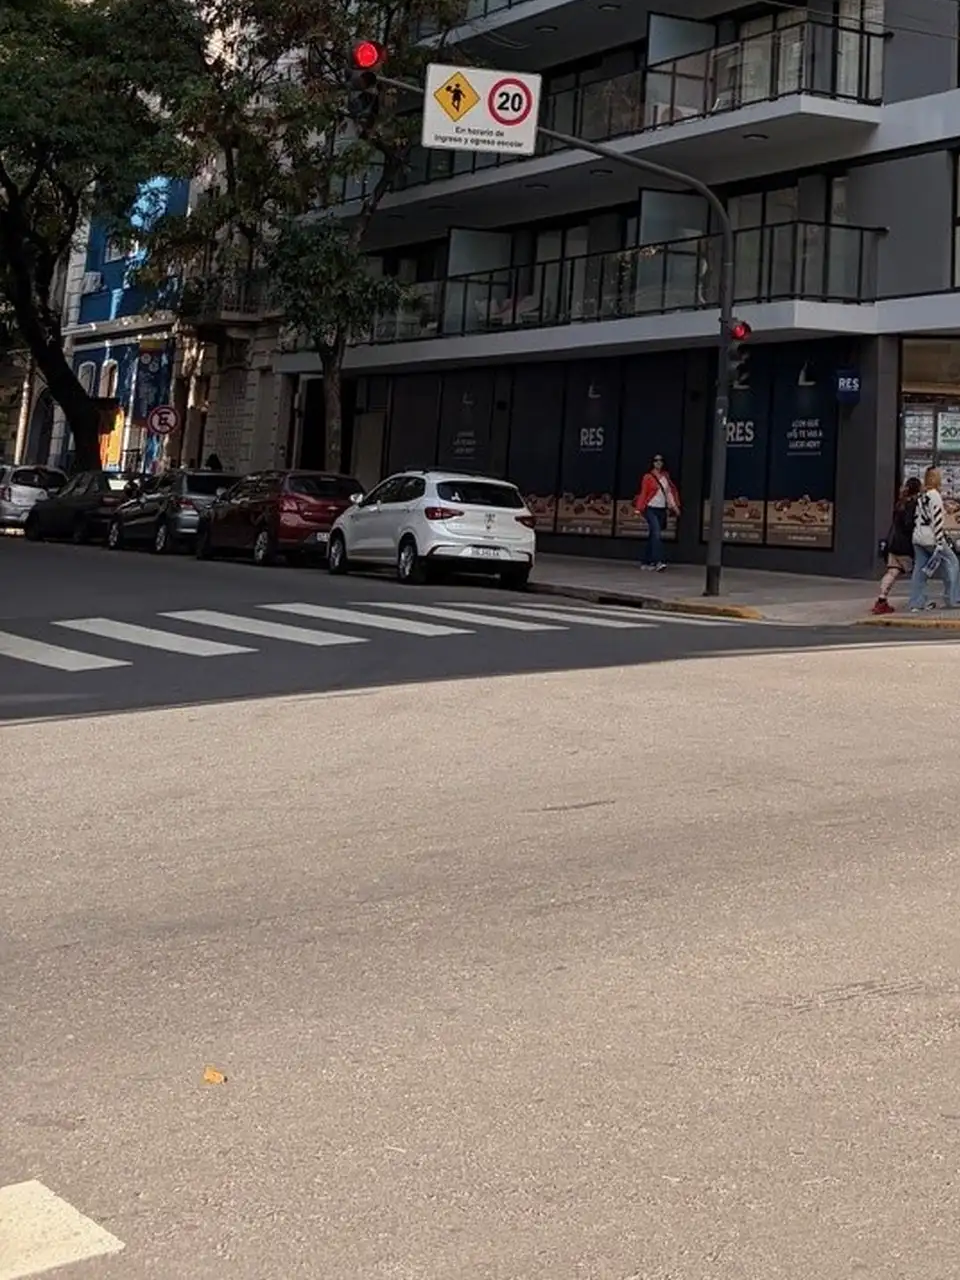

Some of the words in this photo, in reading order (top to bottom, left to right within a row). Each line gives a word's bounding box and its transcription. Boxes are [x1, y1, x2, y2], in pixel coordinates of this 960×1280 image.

[497, 92, 523, 112] 20
[455, 126, 466, 134] En
[468, 127, 494, 137] horario
[495, 129, 504, 137] de
[470, 137, 495, 146] egreso
[496, 139, 523, 147] escolar
[838, 377, 859, 389] RES
[580, 427, 604, 447] RES
[726, 421, 754, 442] RES
